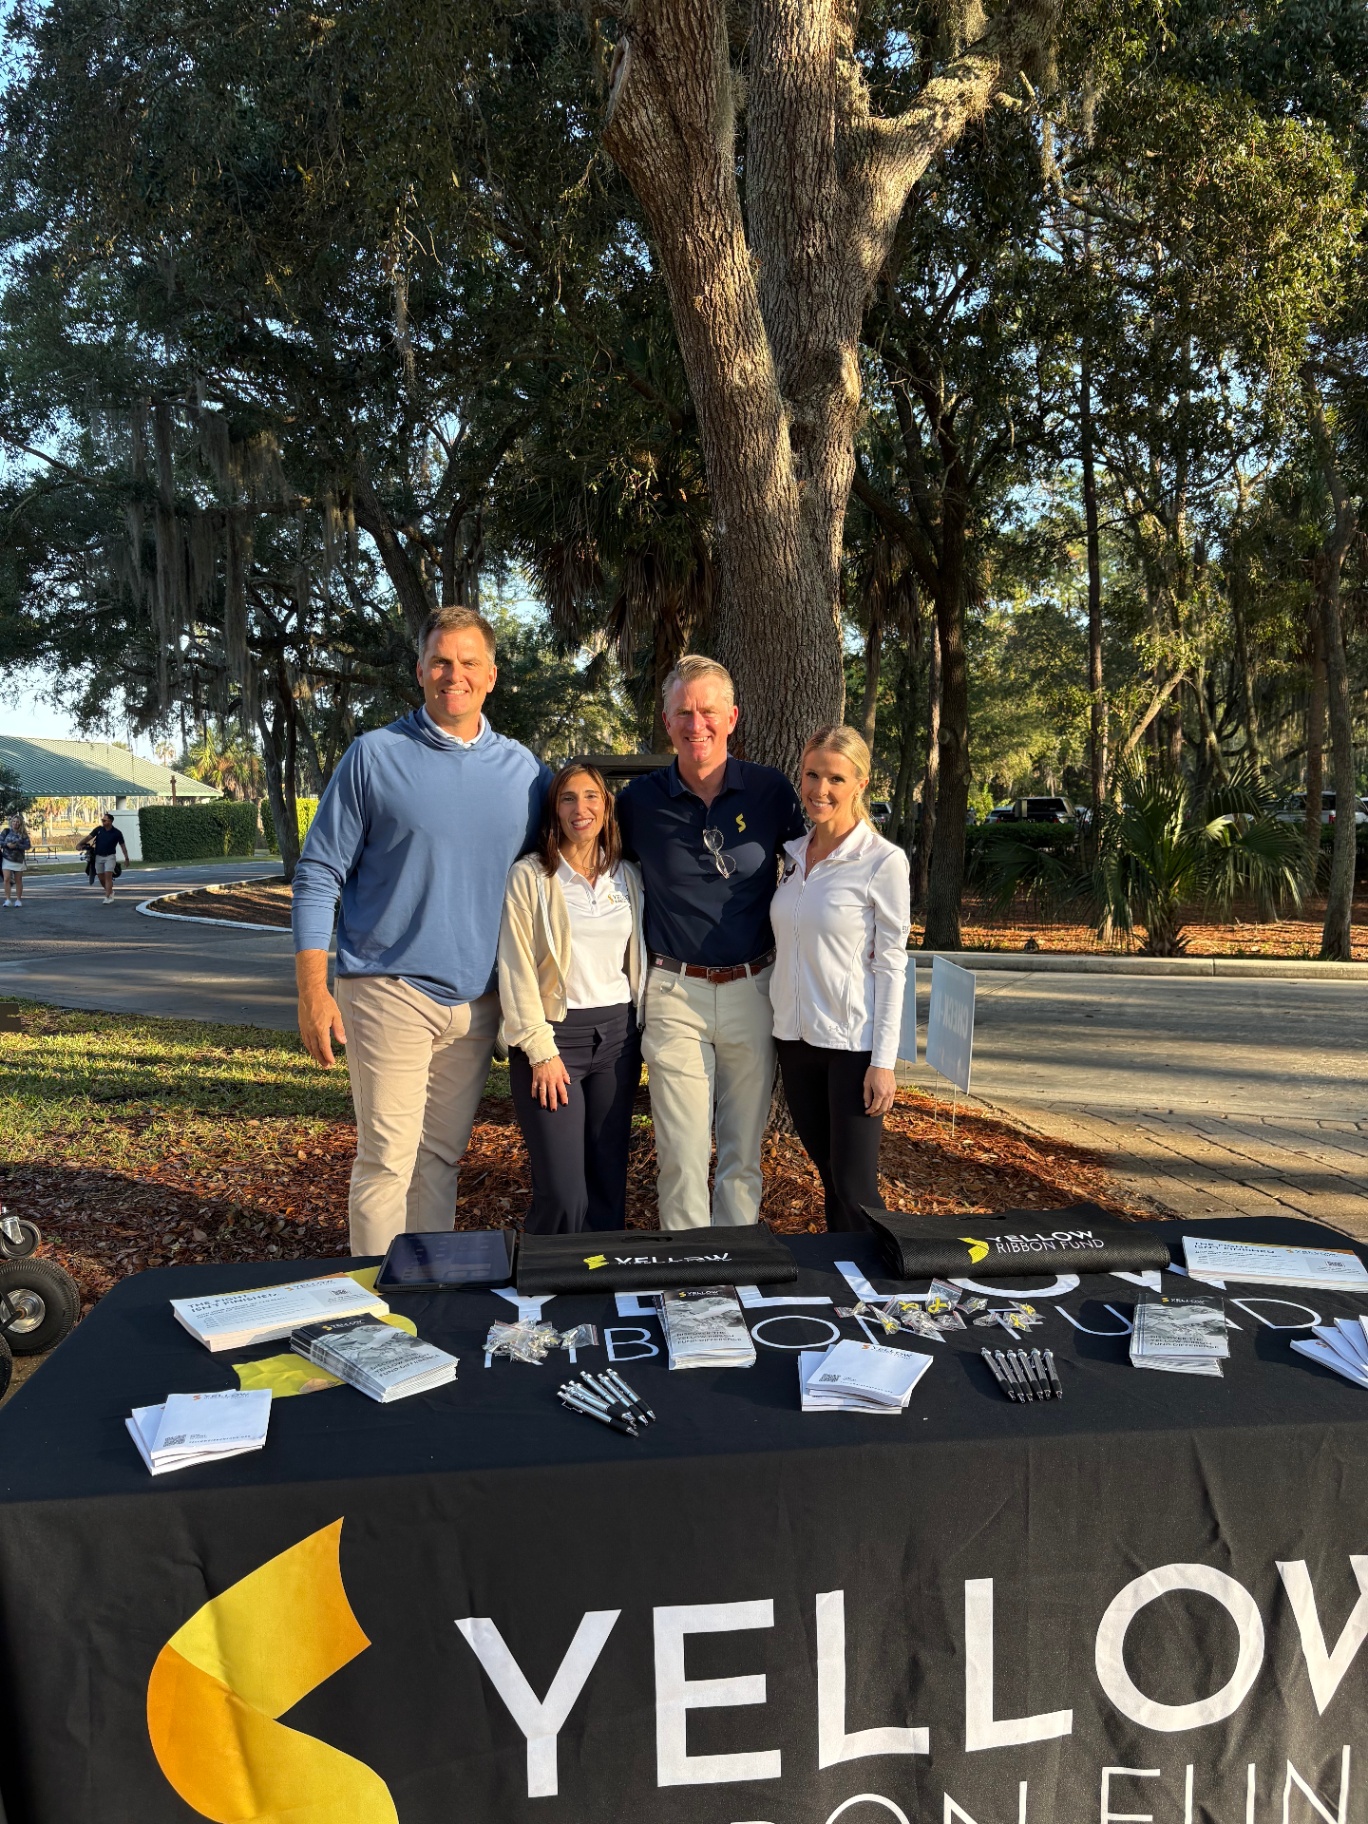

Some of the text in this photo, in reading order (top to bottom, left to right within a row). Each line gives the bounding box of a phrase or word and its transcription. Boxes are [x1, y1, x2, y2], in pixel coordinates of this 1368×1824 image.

[985, 1230, 1094, 1243] YELLOW
[995, 1238, 1105, 1253] RIBBON FUND
[613, 1252, 732, 1265] YELLOW
[986, 1298, 1323, 1341] FUD
[871, 1345, 913, 1358] YELLOW
